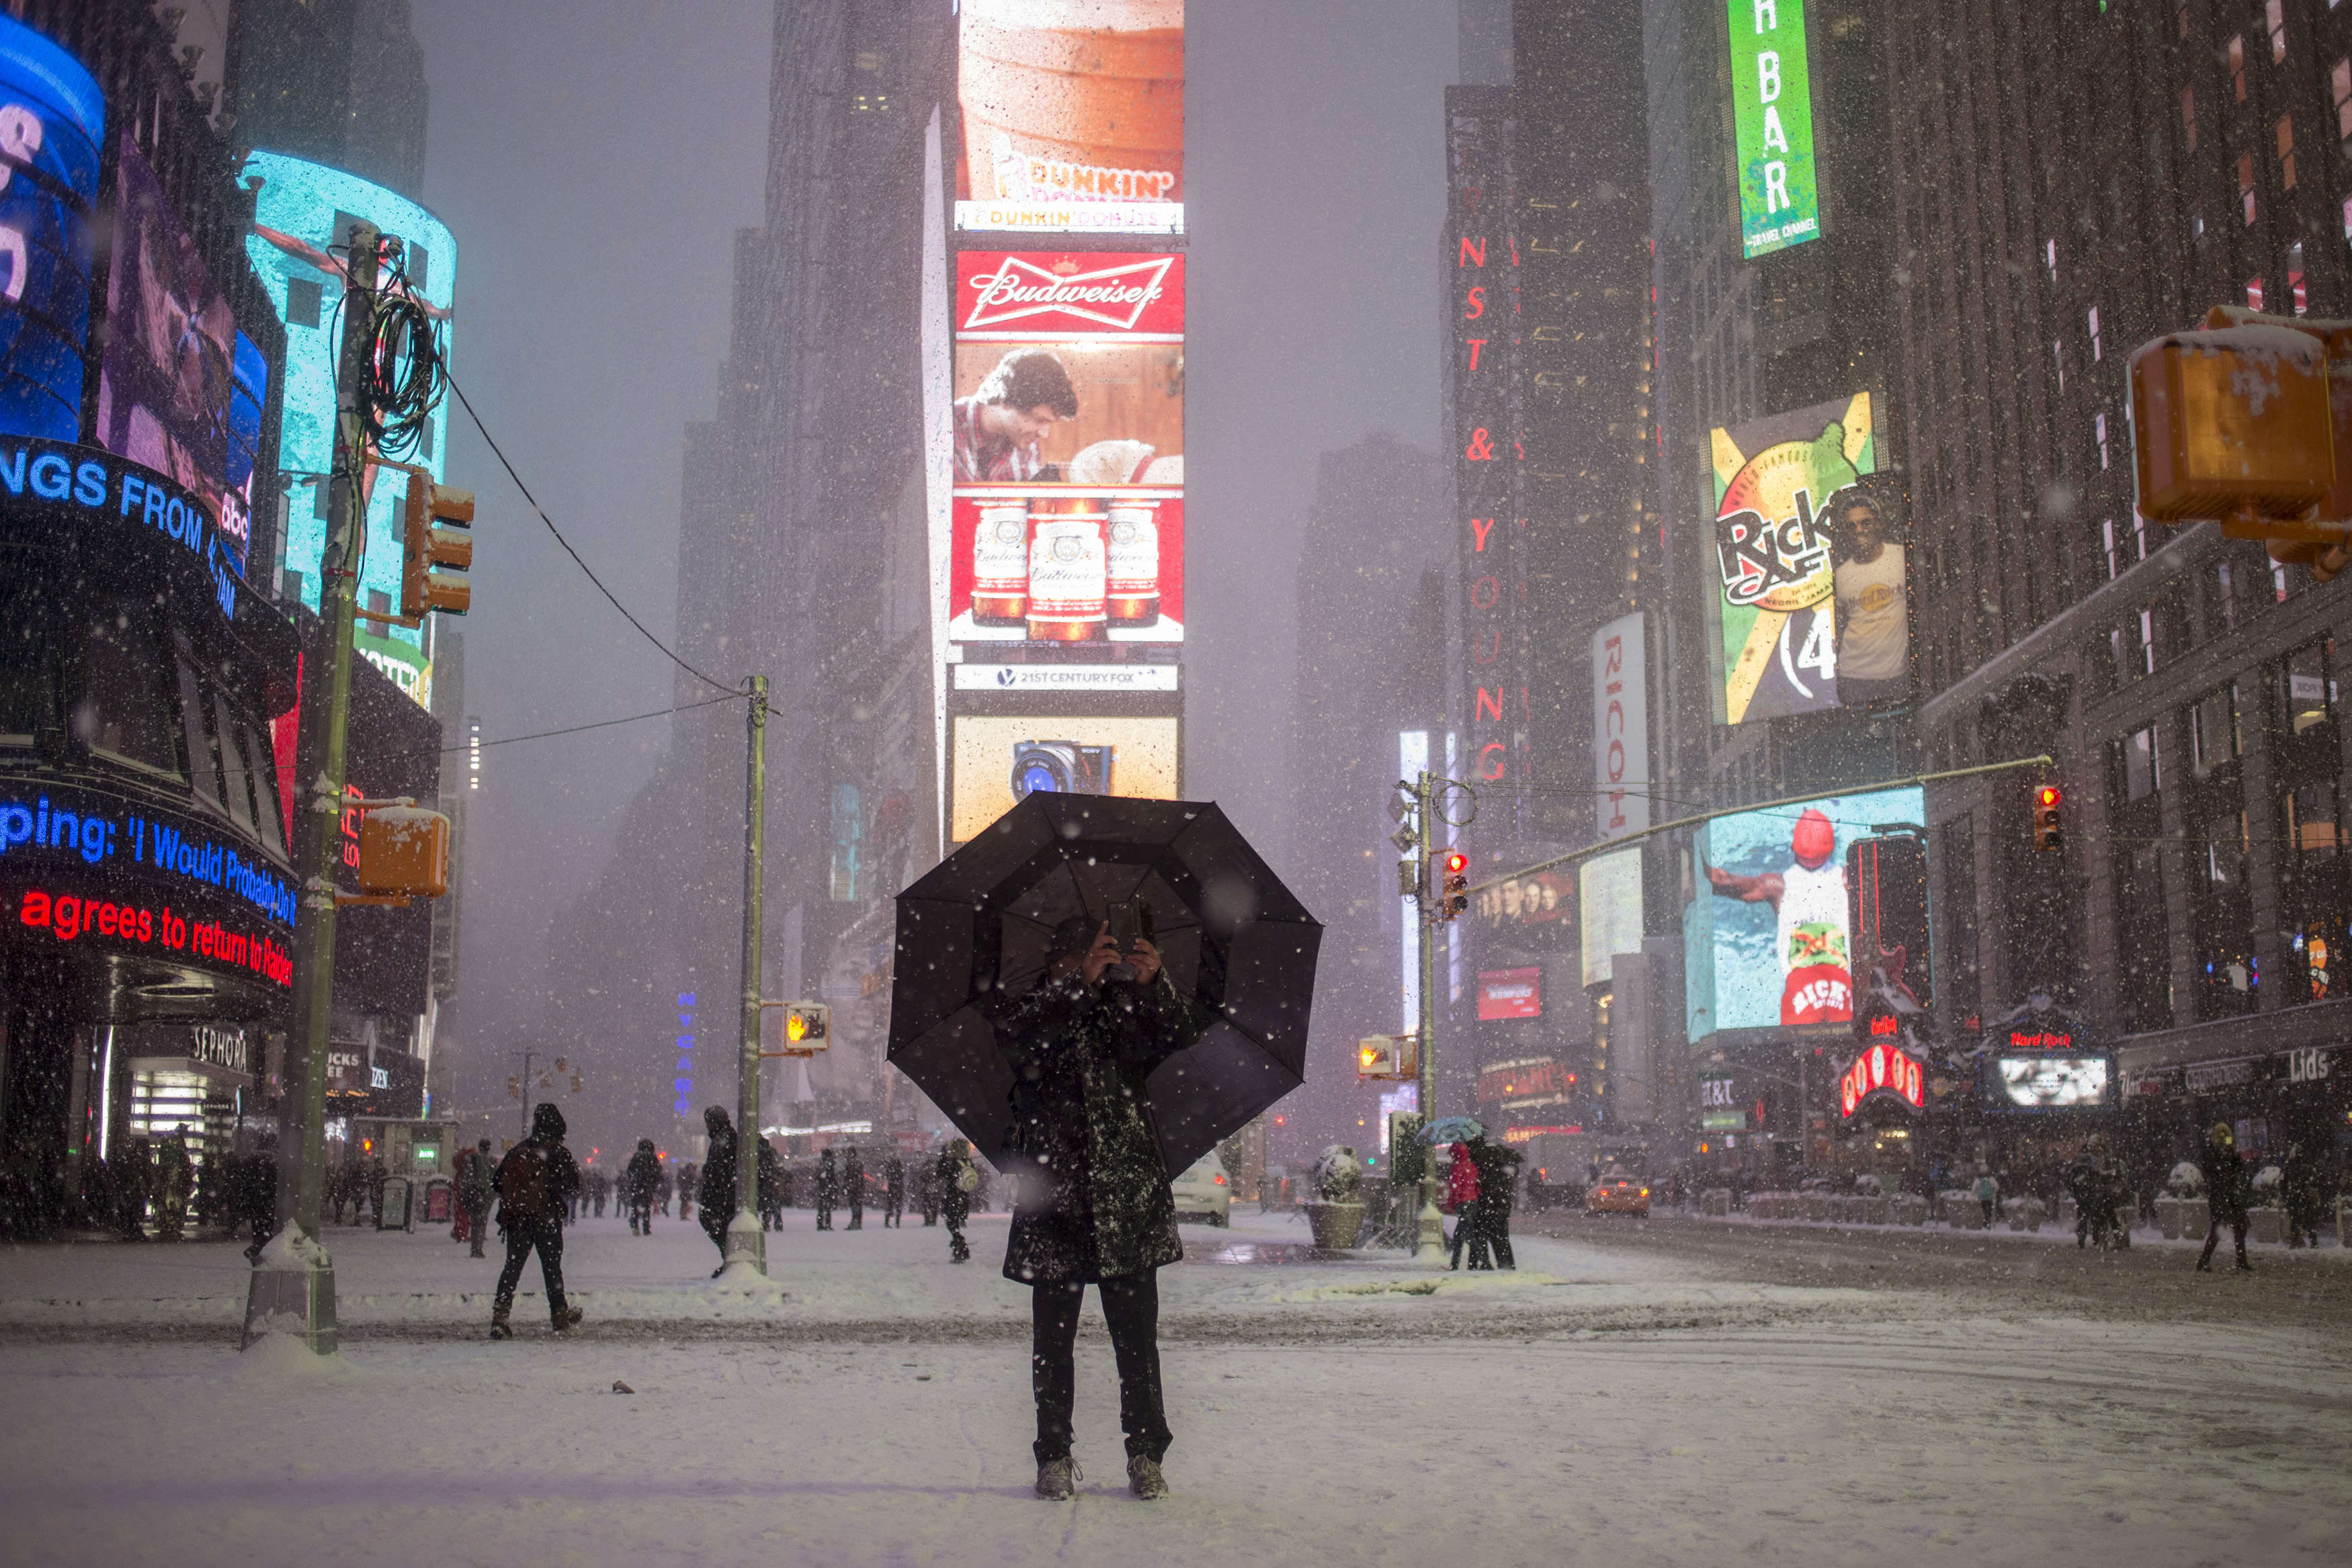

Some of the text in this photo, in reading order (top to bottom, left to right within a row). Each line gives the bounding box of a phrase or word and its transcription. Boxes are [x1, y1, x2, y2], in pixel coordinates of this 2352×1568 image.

[1757, 50, 1790, 214] BAR
[1030, 161, 1169, 198] DUNKIN'
[1078, 211, 1159, 226] DONUTS
[969, 273, 1163, 306] Budweiser
[120, 474, 202, 555] FROM
[221, 500, 248, 541] abc
[1470, 519, 1505, 781] YOUNG
[1021, 672, 1134, 683] 21ST CENTURY FOX
[1605, 634, 1627, 830] RICOH
[153, 822, 223, 886] Would
[226, 850, 277, 920] Probably
[276, 879, 289, 922] Do
[20, 892, 153, 942] agrees
[162, 906, 186, 949] to
[193, 920, 247, 967] return
[250, 932, 261, 972] to
[194, 1027, 247, 1073] SEPHORA
[2011, 1032, 2072, 1049] Hard Rock
[2290, 1048, 2328, 1082] Lids
